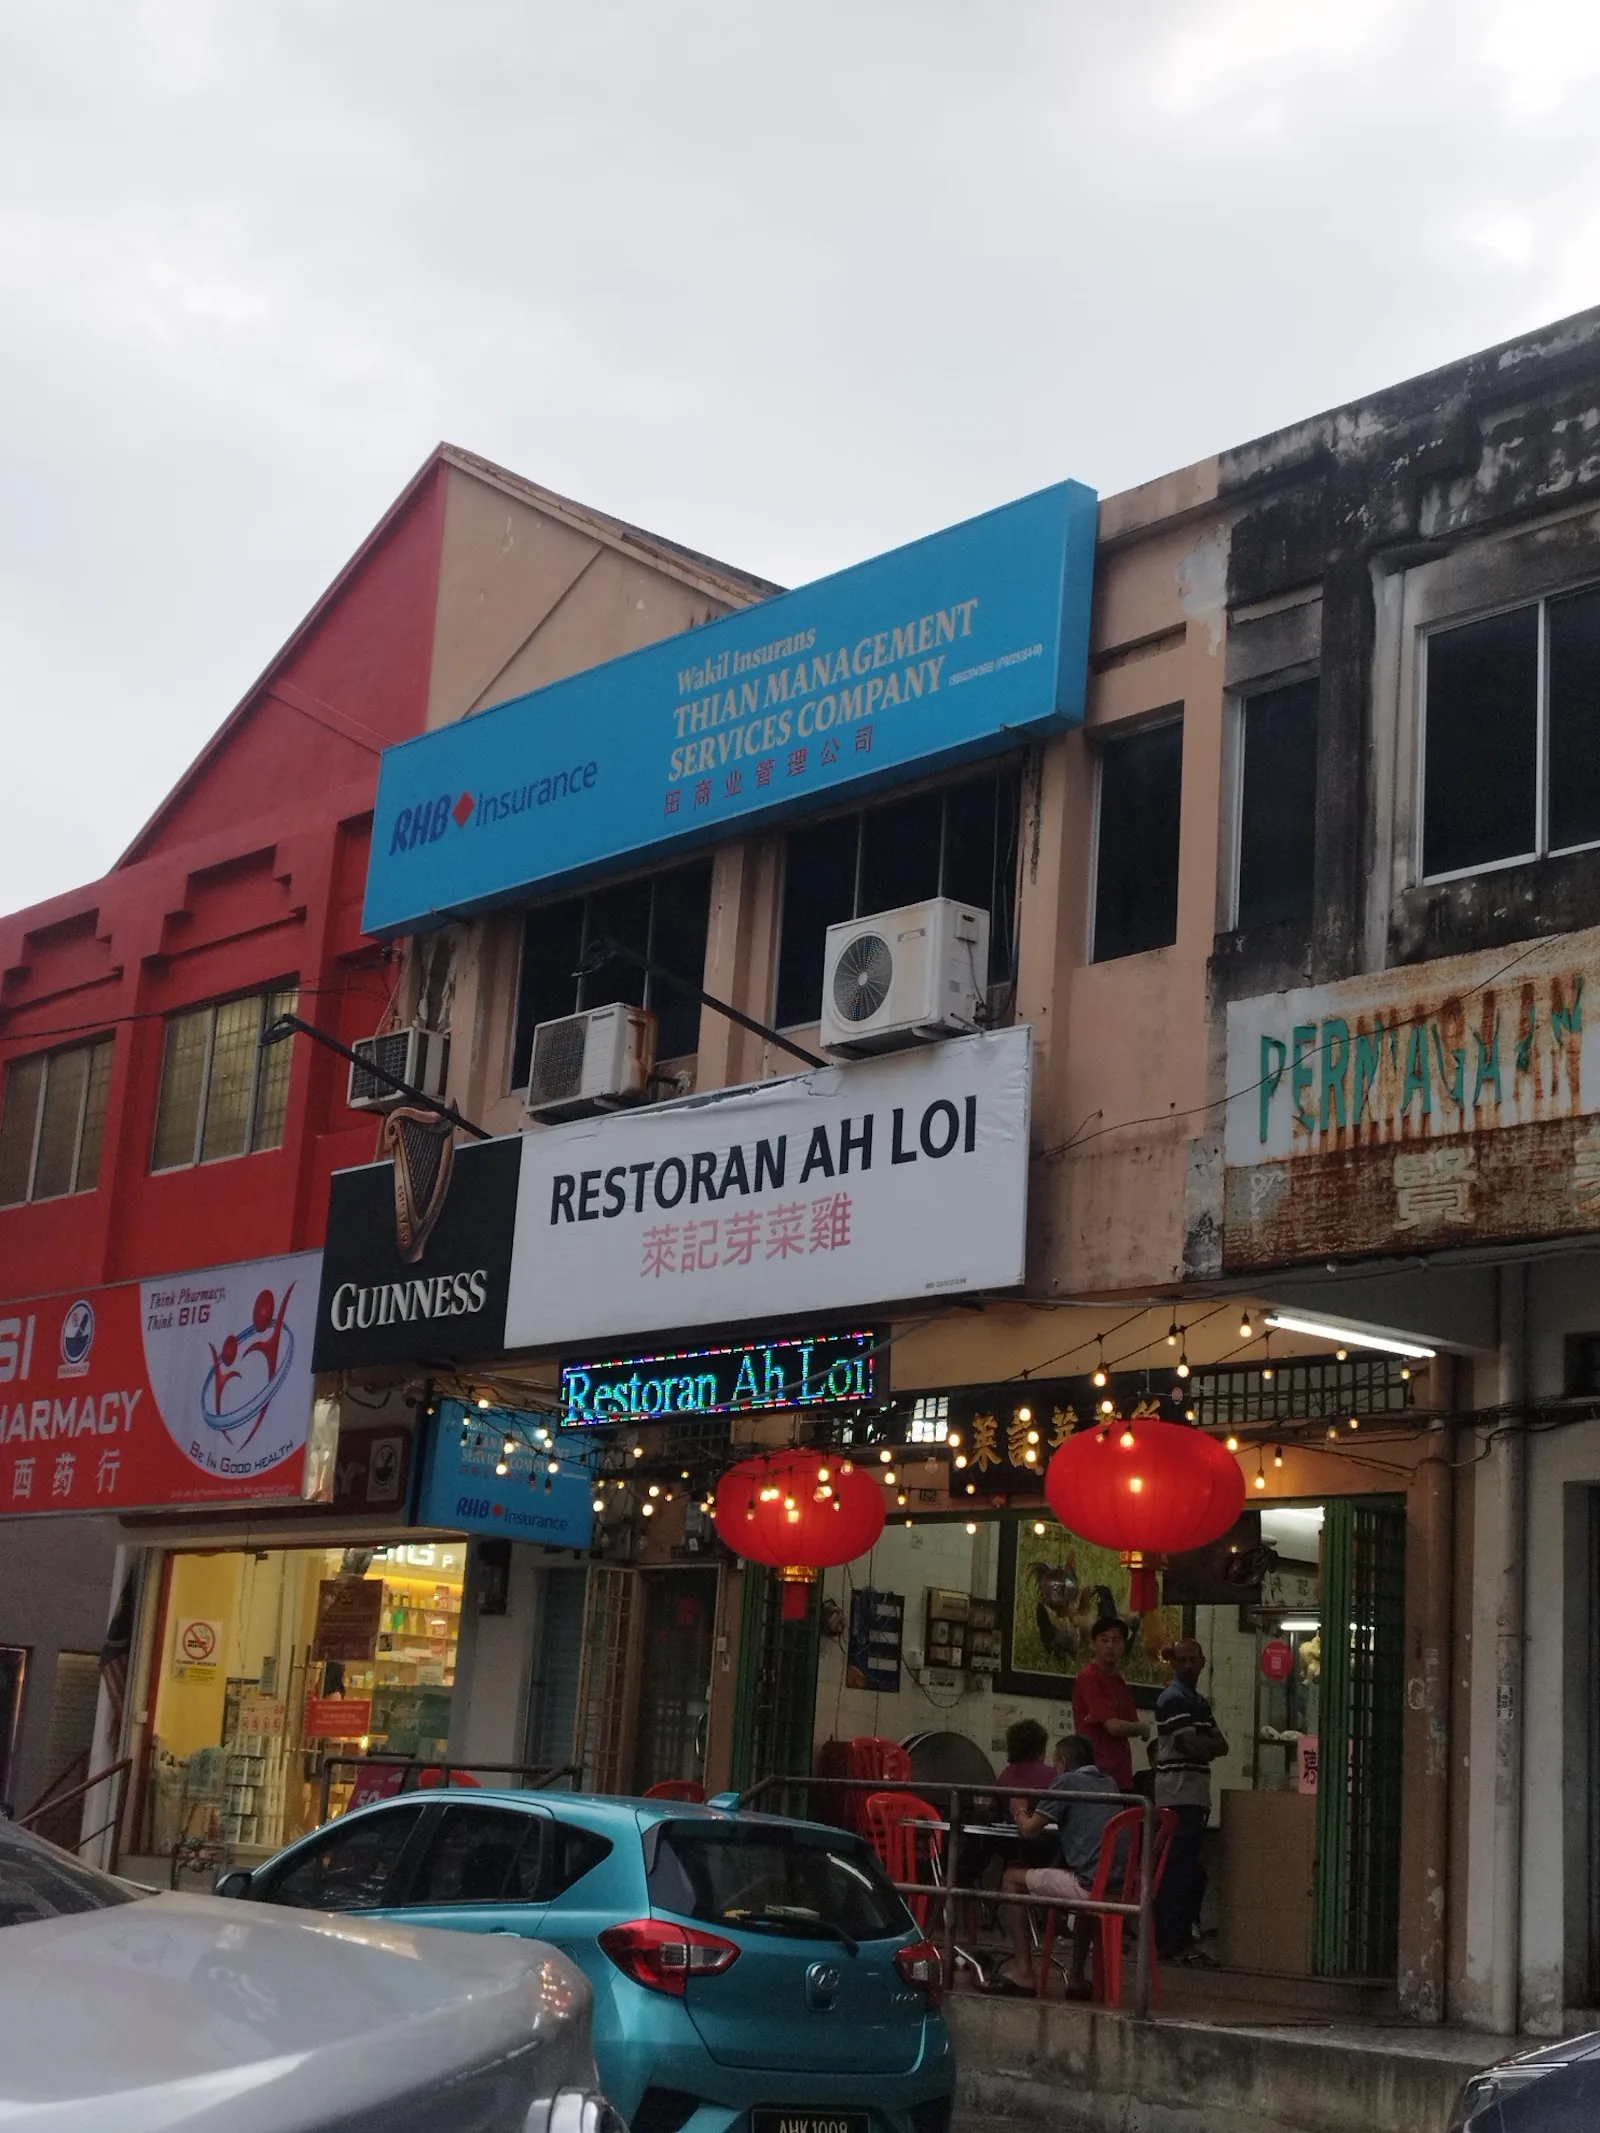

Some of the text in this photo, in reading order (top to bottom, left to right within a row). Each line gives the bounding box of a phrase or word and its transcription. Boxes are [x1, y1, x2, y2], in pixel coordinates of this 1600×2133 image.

[673, 679, 760, 739] THIAN
[762, 598, 980, 709] MANAGEMENT
[678, 627, 817, 695] Wakil Insurans
[668, 709, 793, 783] SERVICES
[797, 655, 947, 739] COMPANY
[389, 760, 599, 857] RHB Insurance
[549, 1095, 977, 1225] RESTORAN AH LOI
[640, 1193, 853, 1278] 萊記芽菜雞
[147, 1305, 210, 1332] Think BIG
[149, 1292, 176, 1309] Think
[330, 1269, 488, 1332] GUINNESS
[564, 1346, 864, 1420] Restoran Ah Loi
[456, 1497, 490, 1518] RHB
